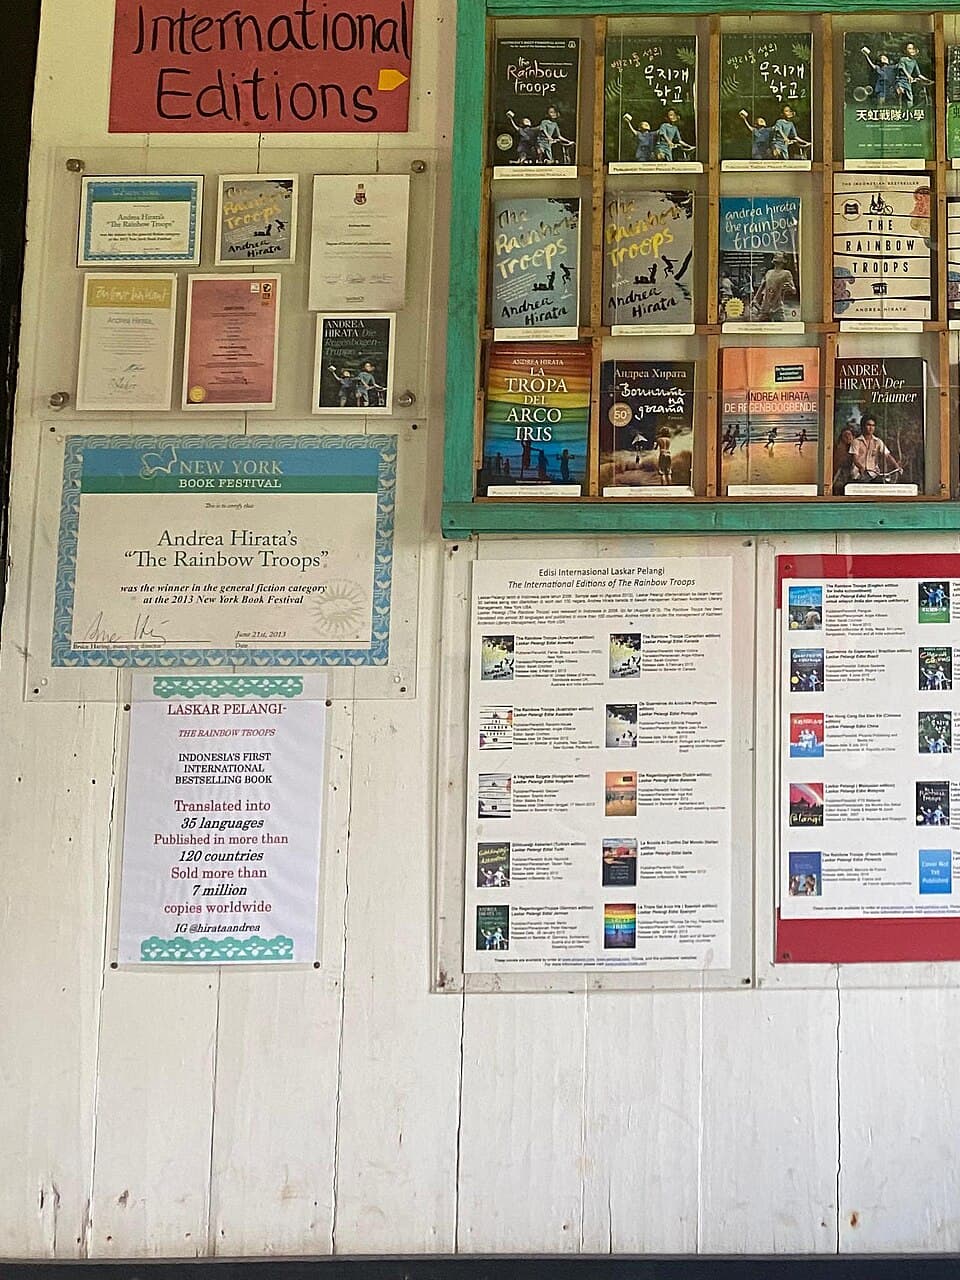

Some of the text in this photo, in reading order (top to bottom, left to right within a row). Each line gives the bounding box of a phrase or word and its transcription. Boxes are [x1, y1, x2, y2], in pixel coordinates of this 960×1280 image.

[507, 60, 567, 80] Rainbow
[156, 68, 378, 122] Editions
[654, 83, 683, 105] 학교
[770, 80, 798, 101] 학교
[725, 201, 796, 221] andrea hirata
[725, 220, 741, 233] the
[868, 220, 893, 231] THE
[733, 230, 789, 250] troops
[846, 240, 915, 252] RAINBOW
[853, 262, 909, 273] TROOPS
[608, 287, 662, 308] Andrea
[502, 297, 554, 319] Andrea
[632, 296, 677, 318] Hirata
[525, 307, 568, 325] Hirata
[530, 368, 545, 376] LA
[615, 369, 686, 378] Андреа Хирата
[840, 365, 887, 376] ANDREA
[505, 379, 568, 393] TROPA
[840, 378, 904, 389] HIRATA Der
[524, 395, 548, 404] DEL
[746, 392, 809, 401] ANDREA HIRATA
[872, 392, 917, 403] Träumer
[725, 403, 736, 413] DE
[507, 409, 562, 423] ARCO
[515, 427, 552, 441] IRIS
[179, 461, 283, 474] NEW YORK
[179, 479, 281, 488] BOOK FESTIVAL
[158, 530, 298, 546] Andrea Hirata’s
[125, 551, 329, 571] “The Rainbow Troops”
[539, 567, 665, 577] Edisi Internasional Laskar Pelangi
[508, 578, 695, 589] The International Editions of The Rainbow Troops
[120, 583, 327, 596] was the winner in the general fiction category
[143, 595, 303, 604] at the 2013 New York Book Festival
[167, 704, 287, 715] LASKAR PELANGI-
[243, 753, 271, 761] FIRST
[184, 764, 264, 773] INTERNATIONAL
[175, 776, 242, 784] BESTSELLING
[174, 800, 270, 812] Translated into
[181, 818, 264, 830] 35 languages
[154, 834, 288, 844] Published in more than
[179, 851, 263, 861] 120 countries
[172, 868, 266, 878] Sold more than
[192, 885, 247, 895] 7 million
[164, 901, 271, 915] copies worldwide
[174, 923, 187, 933] IG
